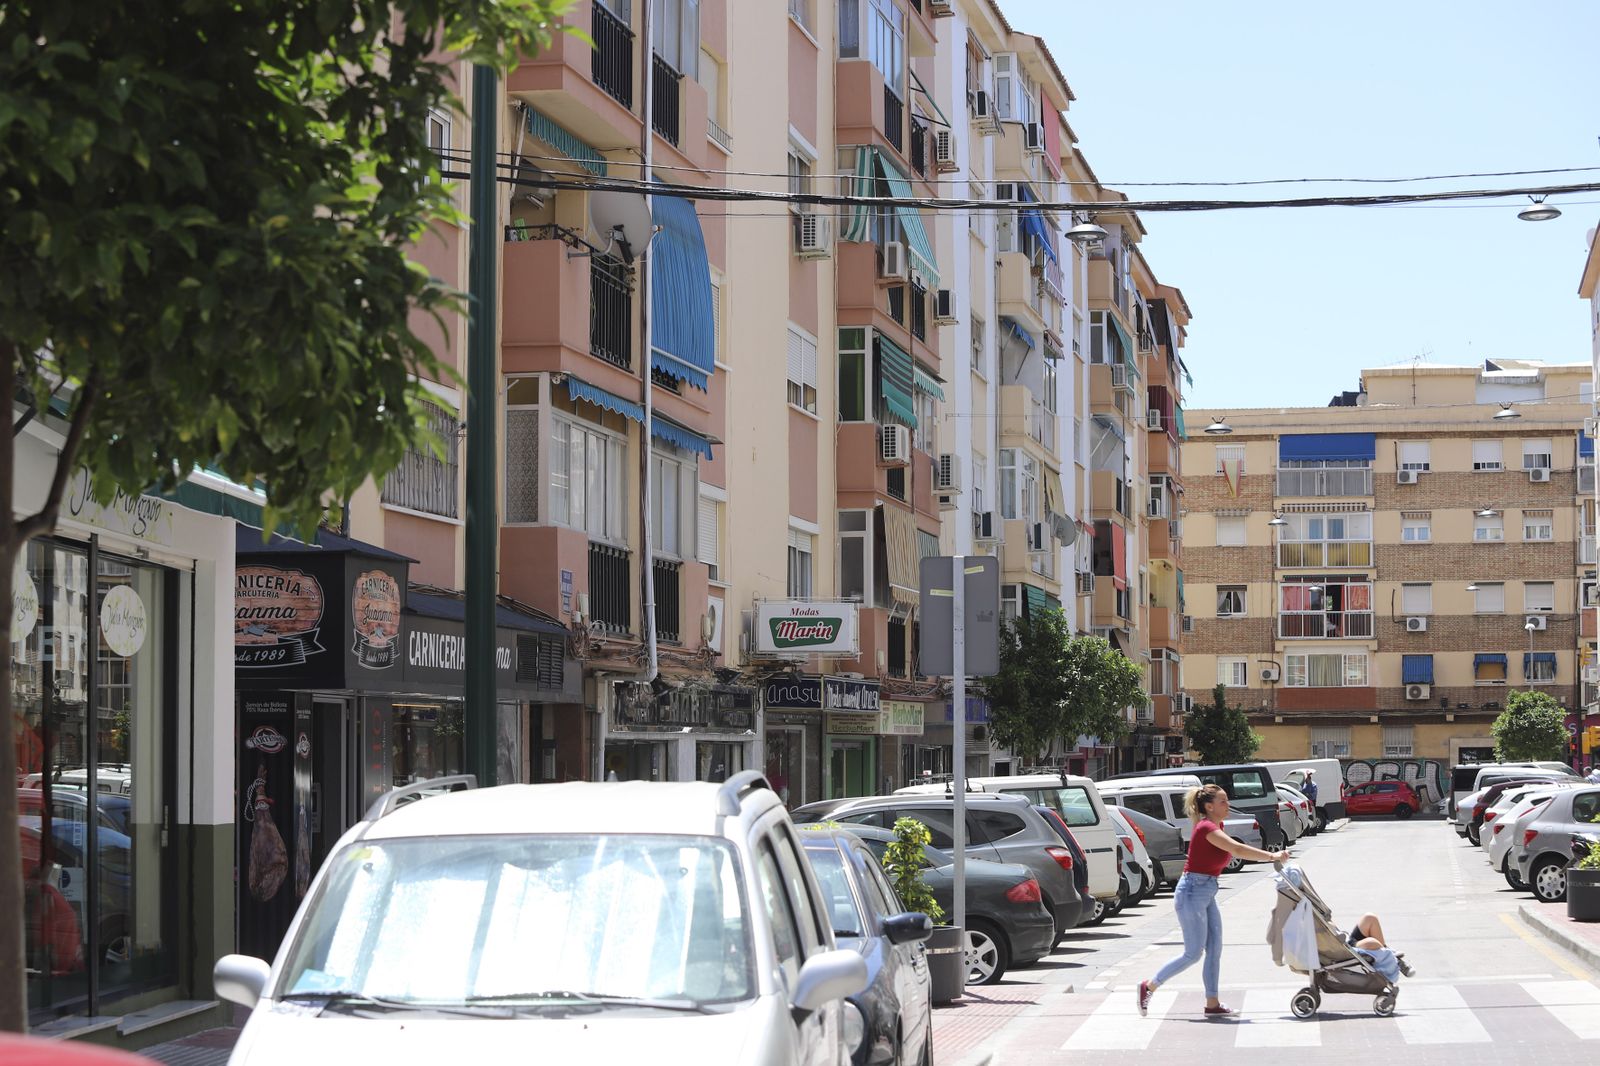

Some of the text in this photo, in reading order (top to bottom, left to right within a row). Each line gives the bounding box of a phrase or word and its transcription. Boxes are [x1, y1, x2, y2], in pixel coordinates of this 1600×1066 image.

[236, 575, 301, 596] NICERÍA
[235, 606, 297, 619] anma
[790, 606, 820, 616] Modas
[776, 620, 834, 642] Marin
[254, 649, 286, 661] 1989
[409, 630, 465, 670] CARNICERIA
